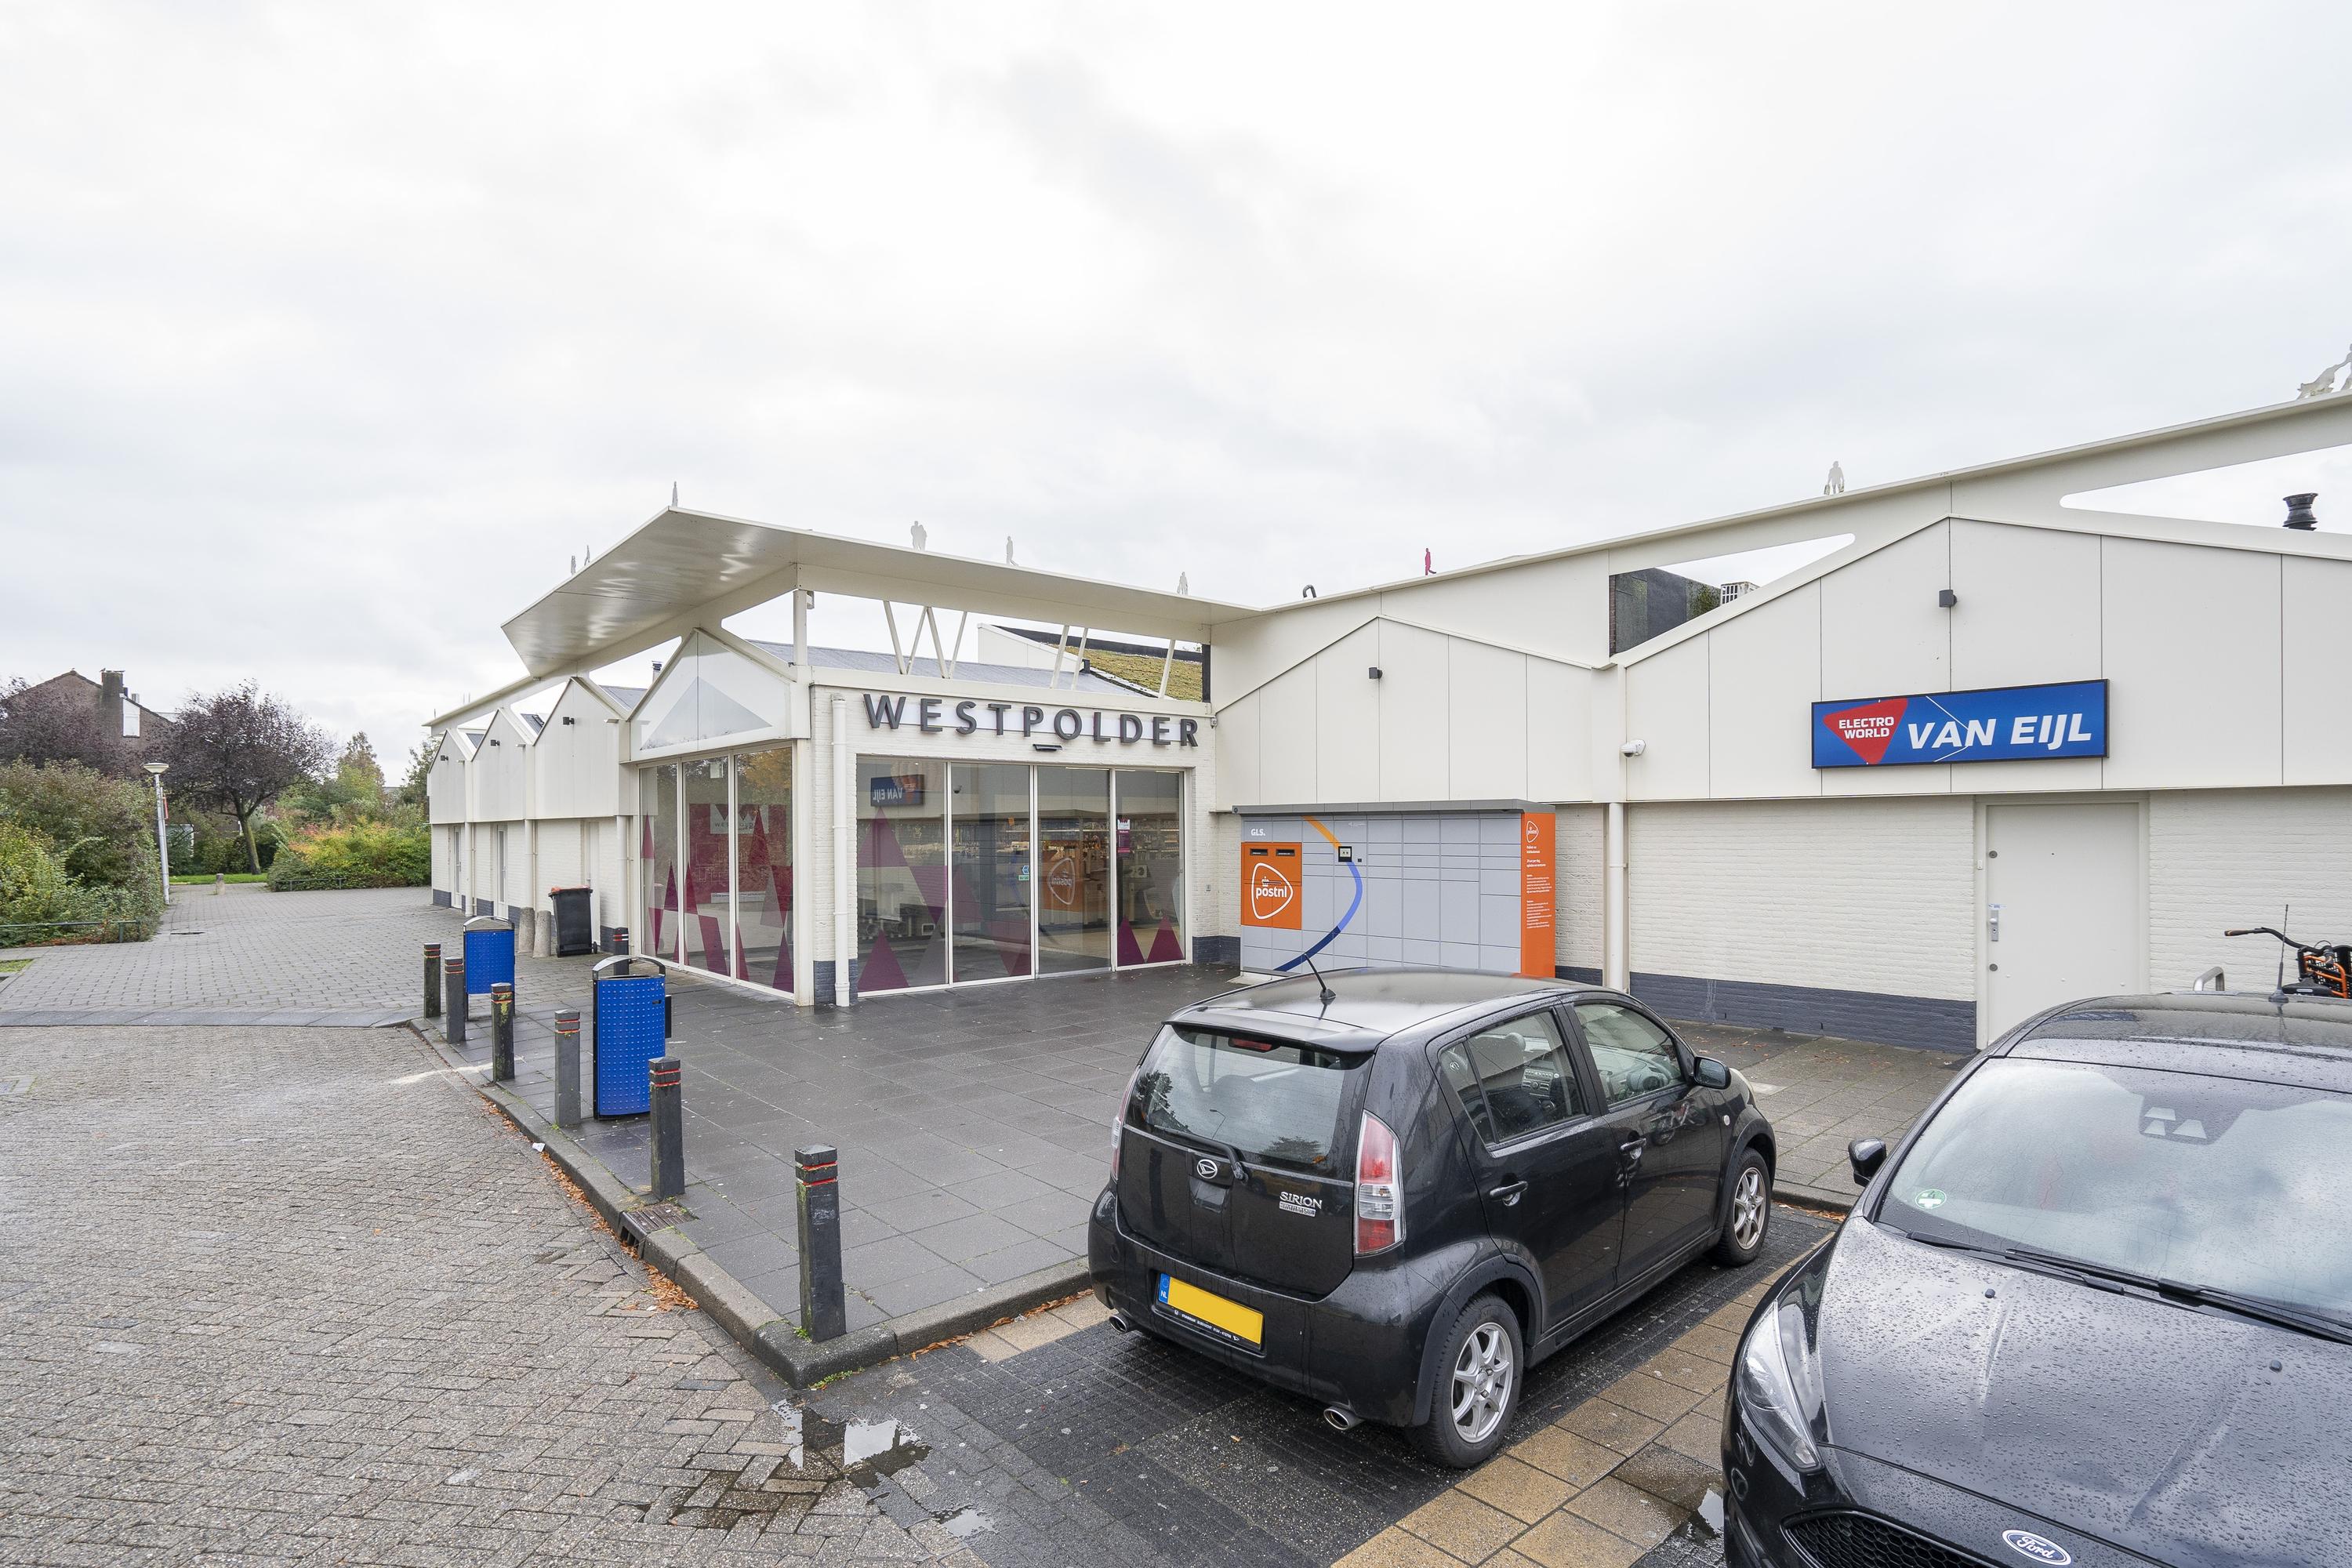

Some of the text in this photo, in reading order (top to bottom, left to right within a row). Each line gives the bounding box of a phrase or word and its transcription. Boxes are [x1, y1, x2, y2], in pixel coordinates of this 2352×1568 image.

[862, 693, 1199, 747] WESTPOLDER
[1838, 717, 1895, 729] ELECTRO
[1844, 728, 1890, 739] WORLD
[1907, 713, 2092, 750] VAN EIJL
[1256, 886, 1287, 900] postnl
[1279, 1191, 1323, 1210] SIRION
[1160, 1290, 1167, 1299] NL
[2016, 1536, 2056, 1559] Ford
